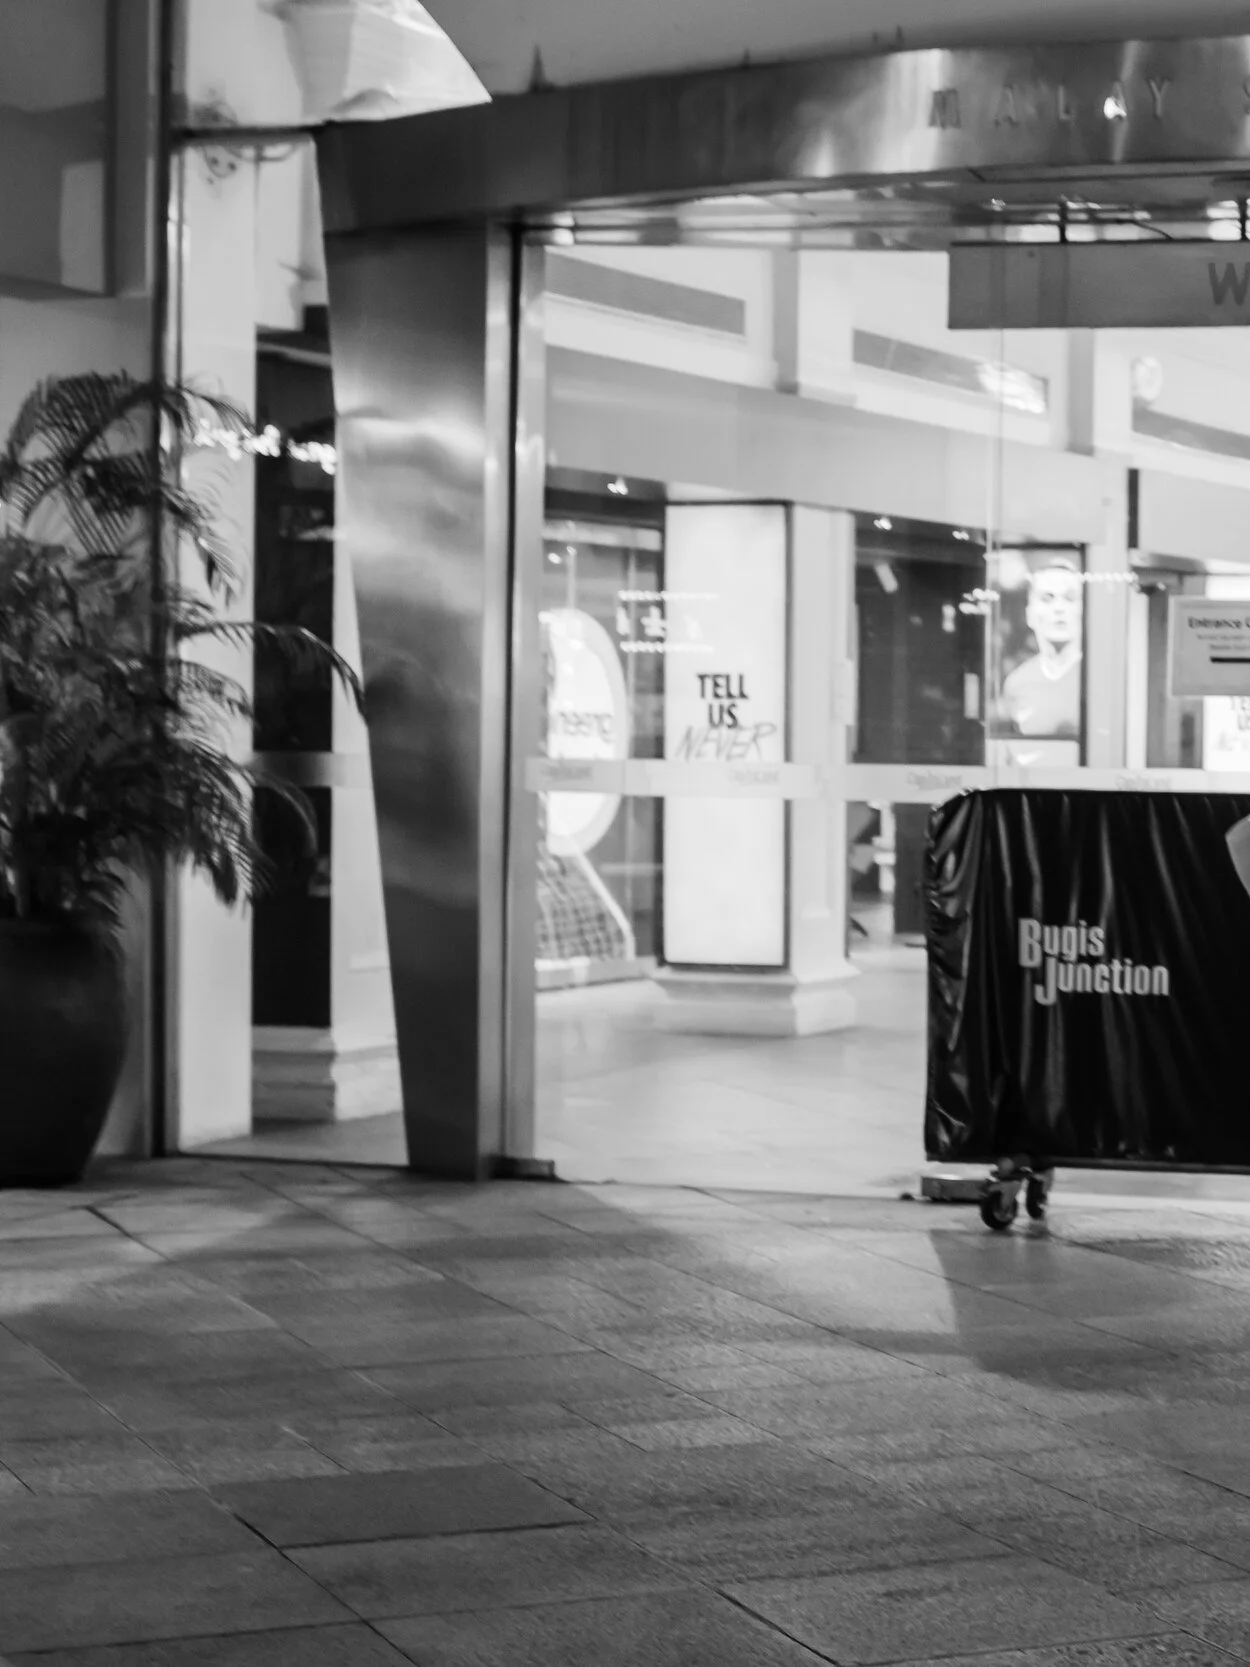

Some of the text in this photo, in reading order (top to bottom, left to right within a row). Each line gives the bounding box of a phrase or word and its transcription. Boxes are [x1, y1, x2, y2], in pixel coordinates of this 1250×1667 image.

[928, 79, 1172, 129] MALAY
[697, 673, 749, 700] TELL
[708, 703, 739, 729] US
[674, 721, 777, 763] NEVER
[1018, 917, 1105, 968] Bugis
[1034, 955, 1170, 1006] Junction
